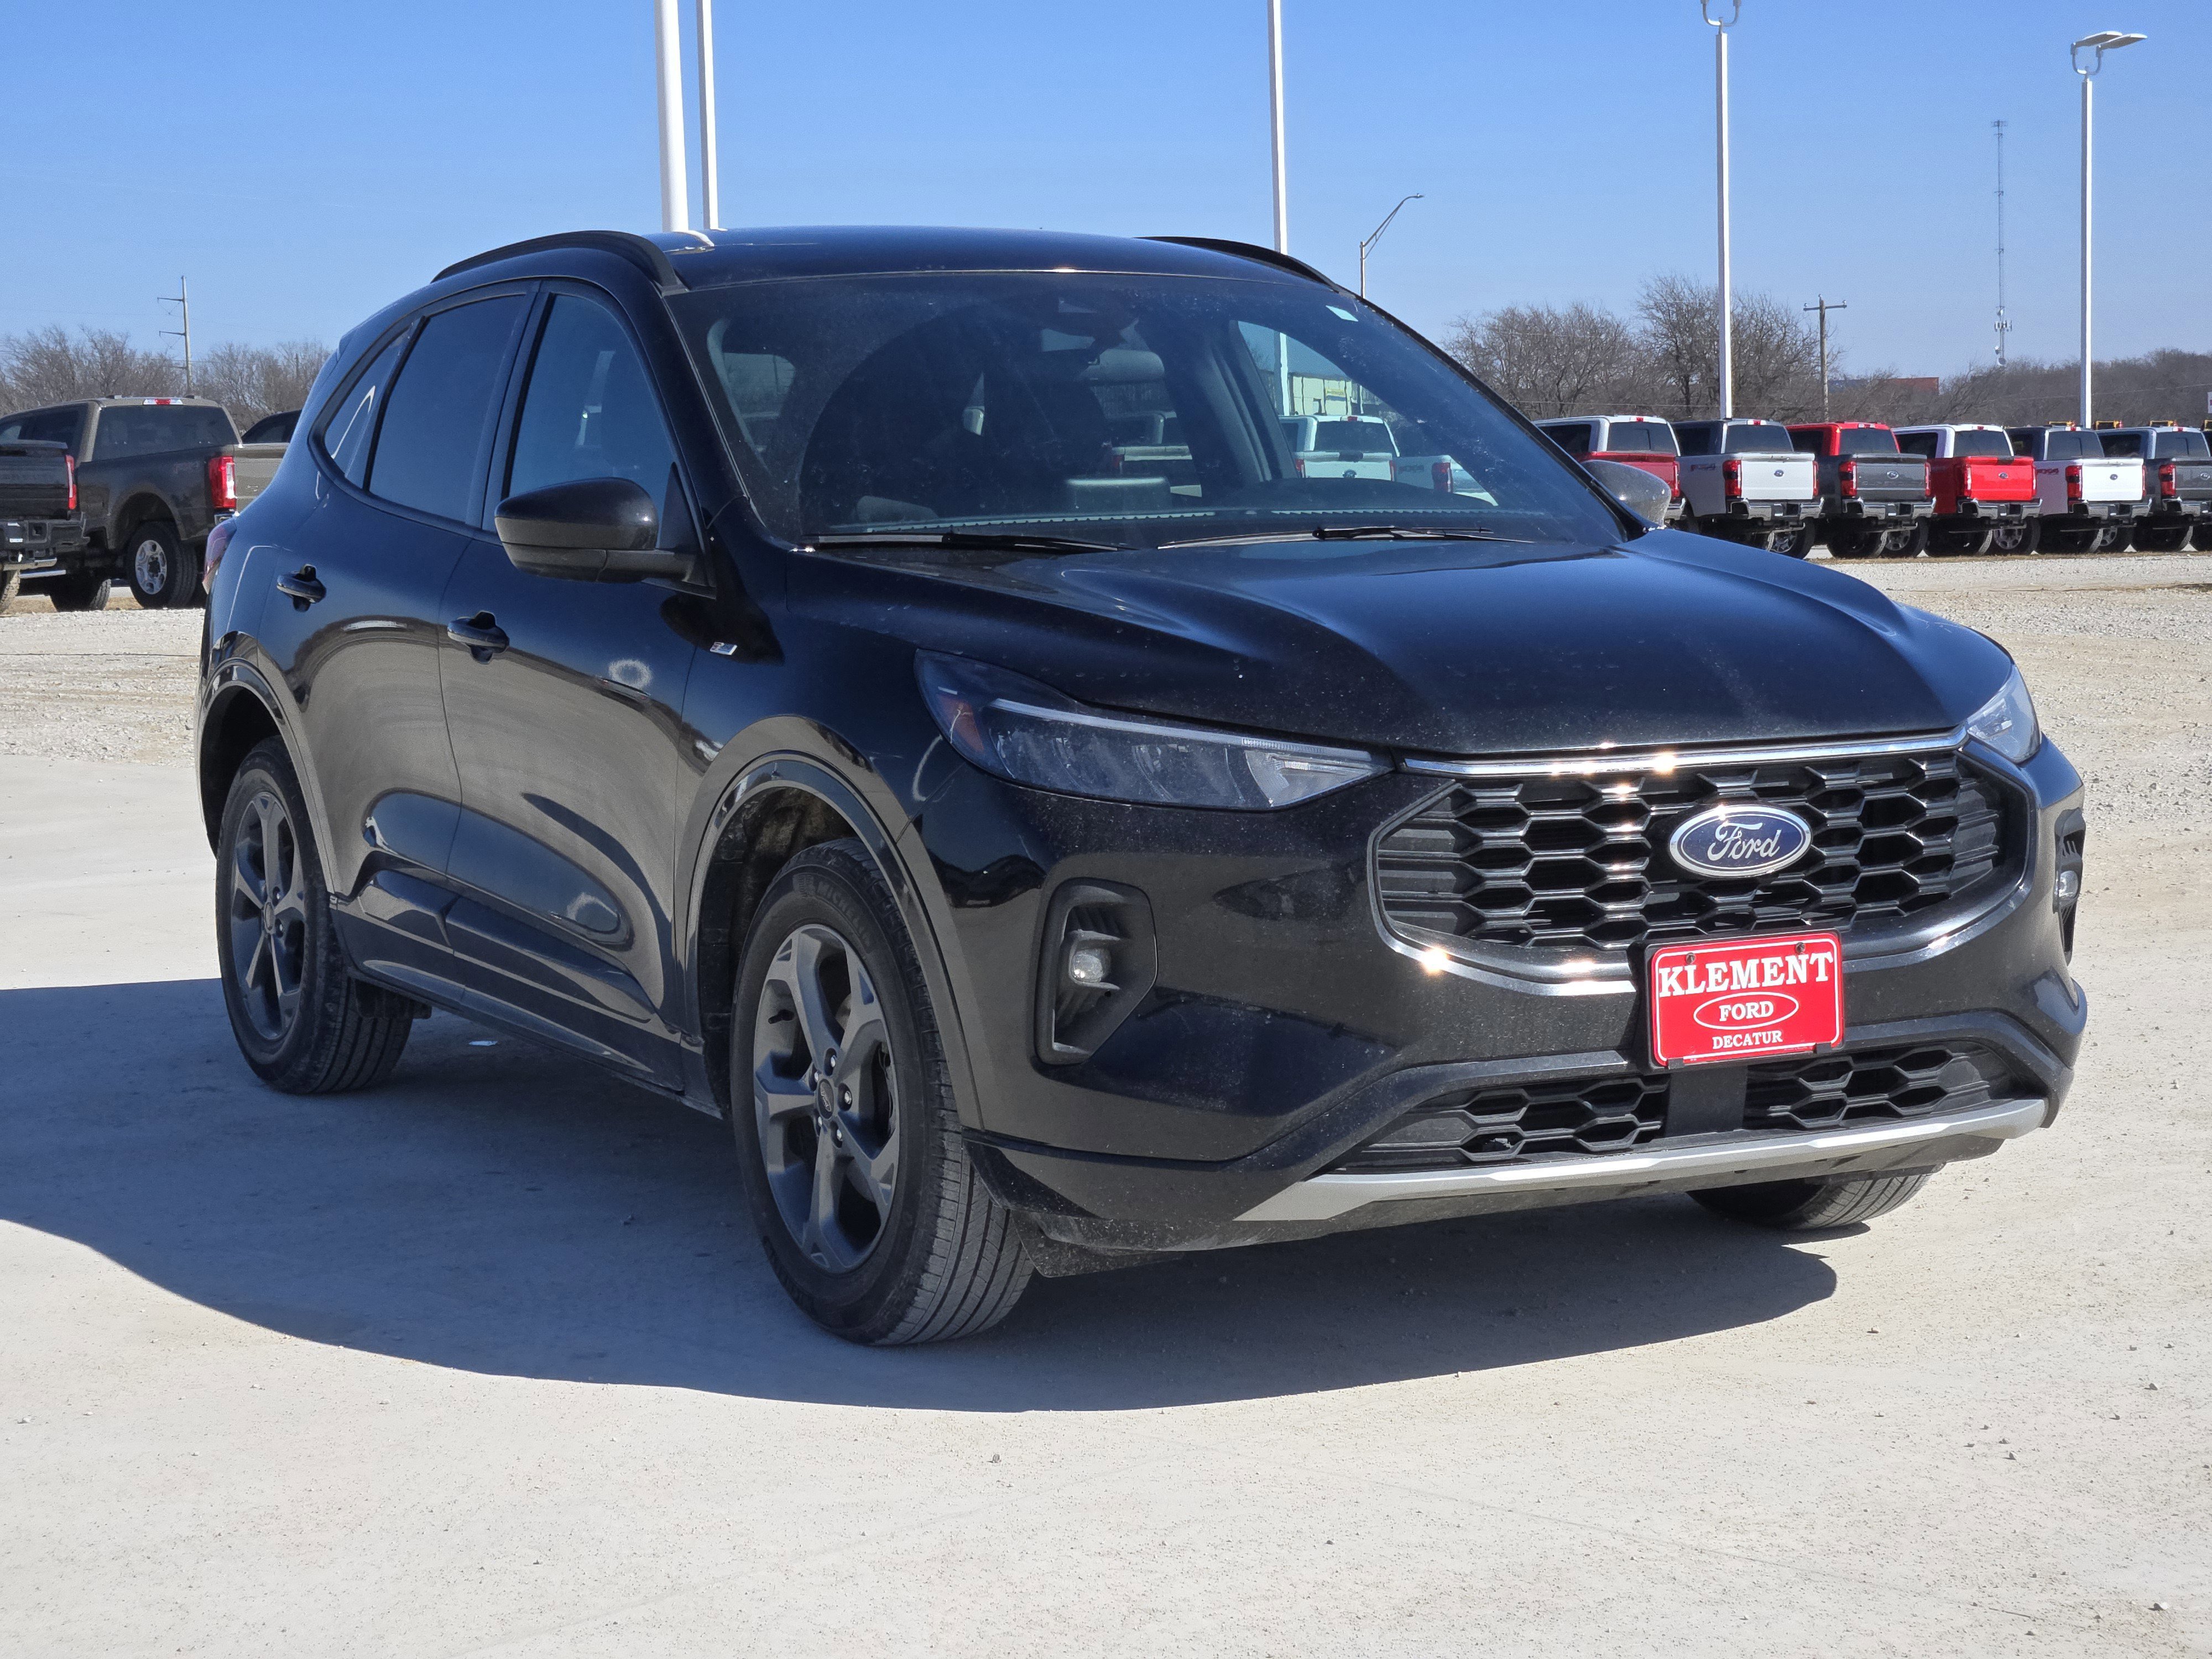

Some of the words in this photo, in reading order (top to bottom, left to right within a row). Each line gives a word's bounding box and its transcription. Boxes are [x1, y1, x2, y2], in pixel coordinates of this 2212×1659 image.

[1707, 822, 1782, 861] Ford
[1658, 951, 1834, 998] KLEMENT
[1719, 1000, 1774, 1022] FORD
[1712, 1030, 1783, 1050] DECATUR
